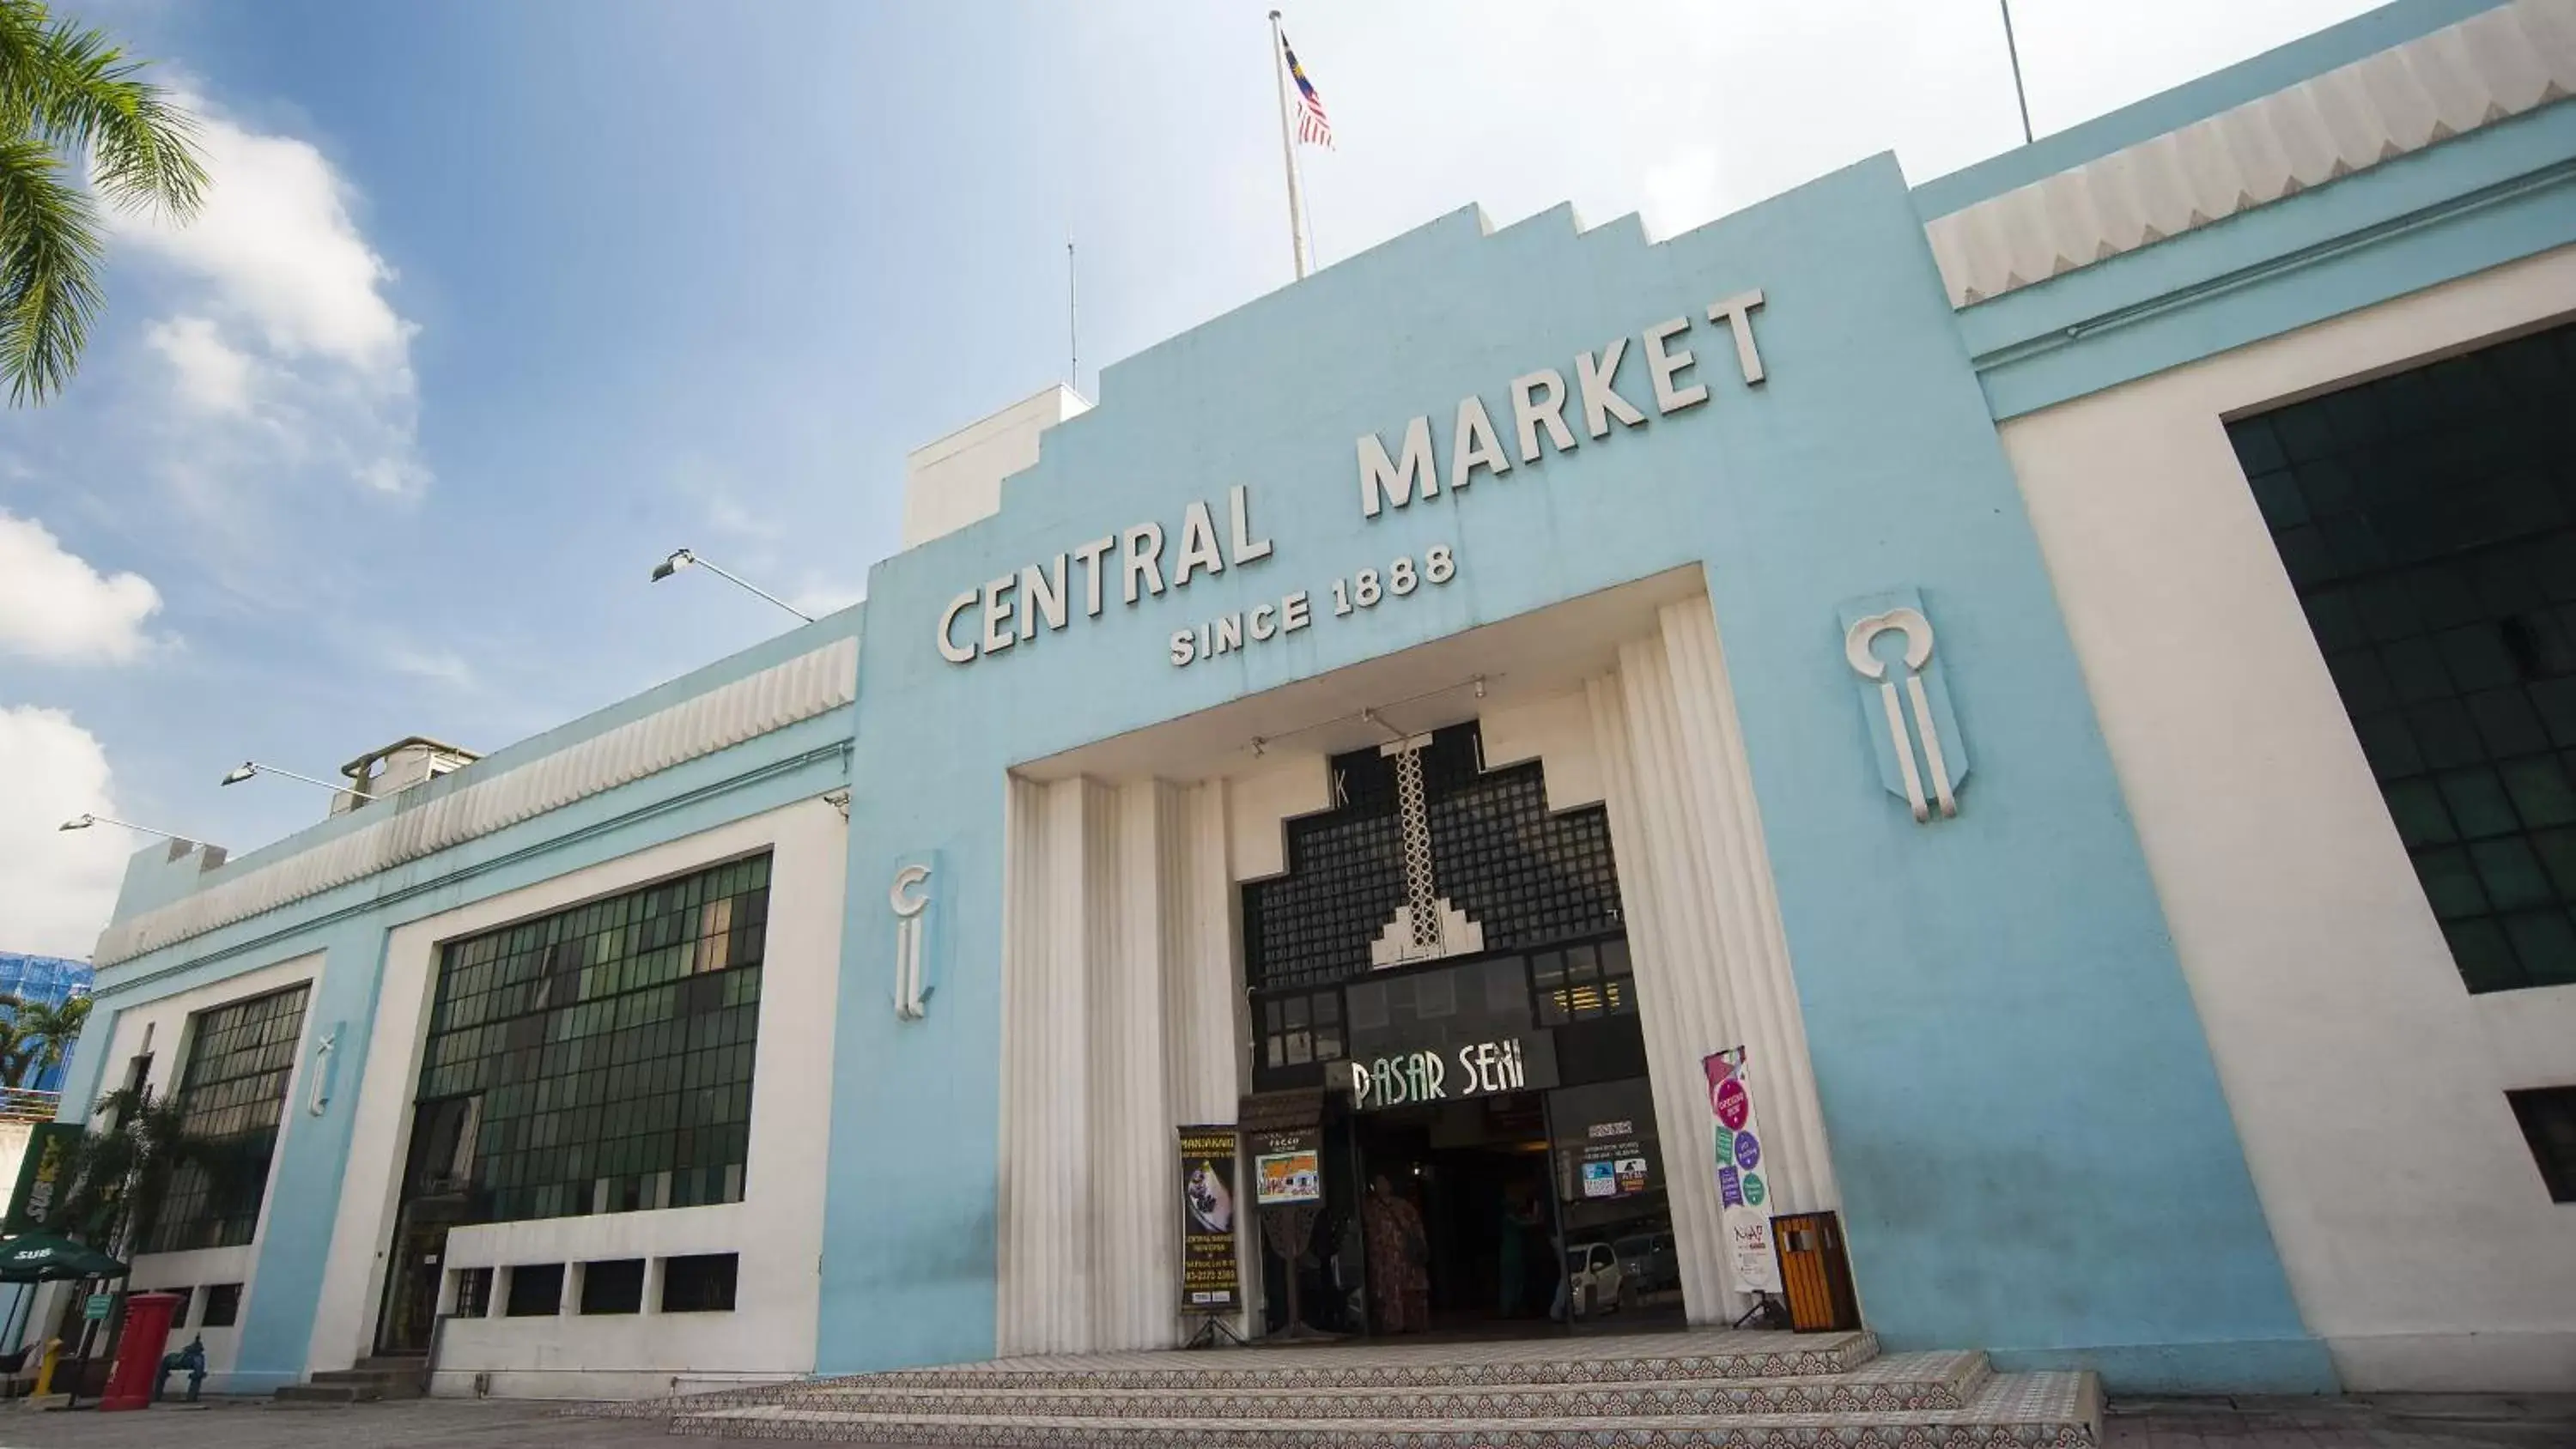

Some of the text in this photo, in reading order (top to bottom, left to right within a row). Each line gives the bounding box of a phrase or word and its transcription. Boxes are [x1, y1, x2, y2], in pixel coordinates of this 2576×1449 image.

[938, 288, 1765, 663] CENTRAL MARKET
[1170, 544, 1455, 666] SINCE 1888
[1352, 1039, 1524, 1109] PASAR SENI
